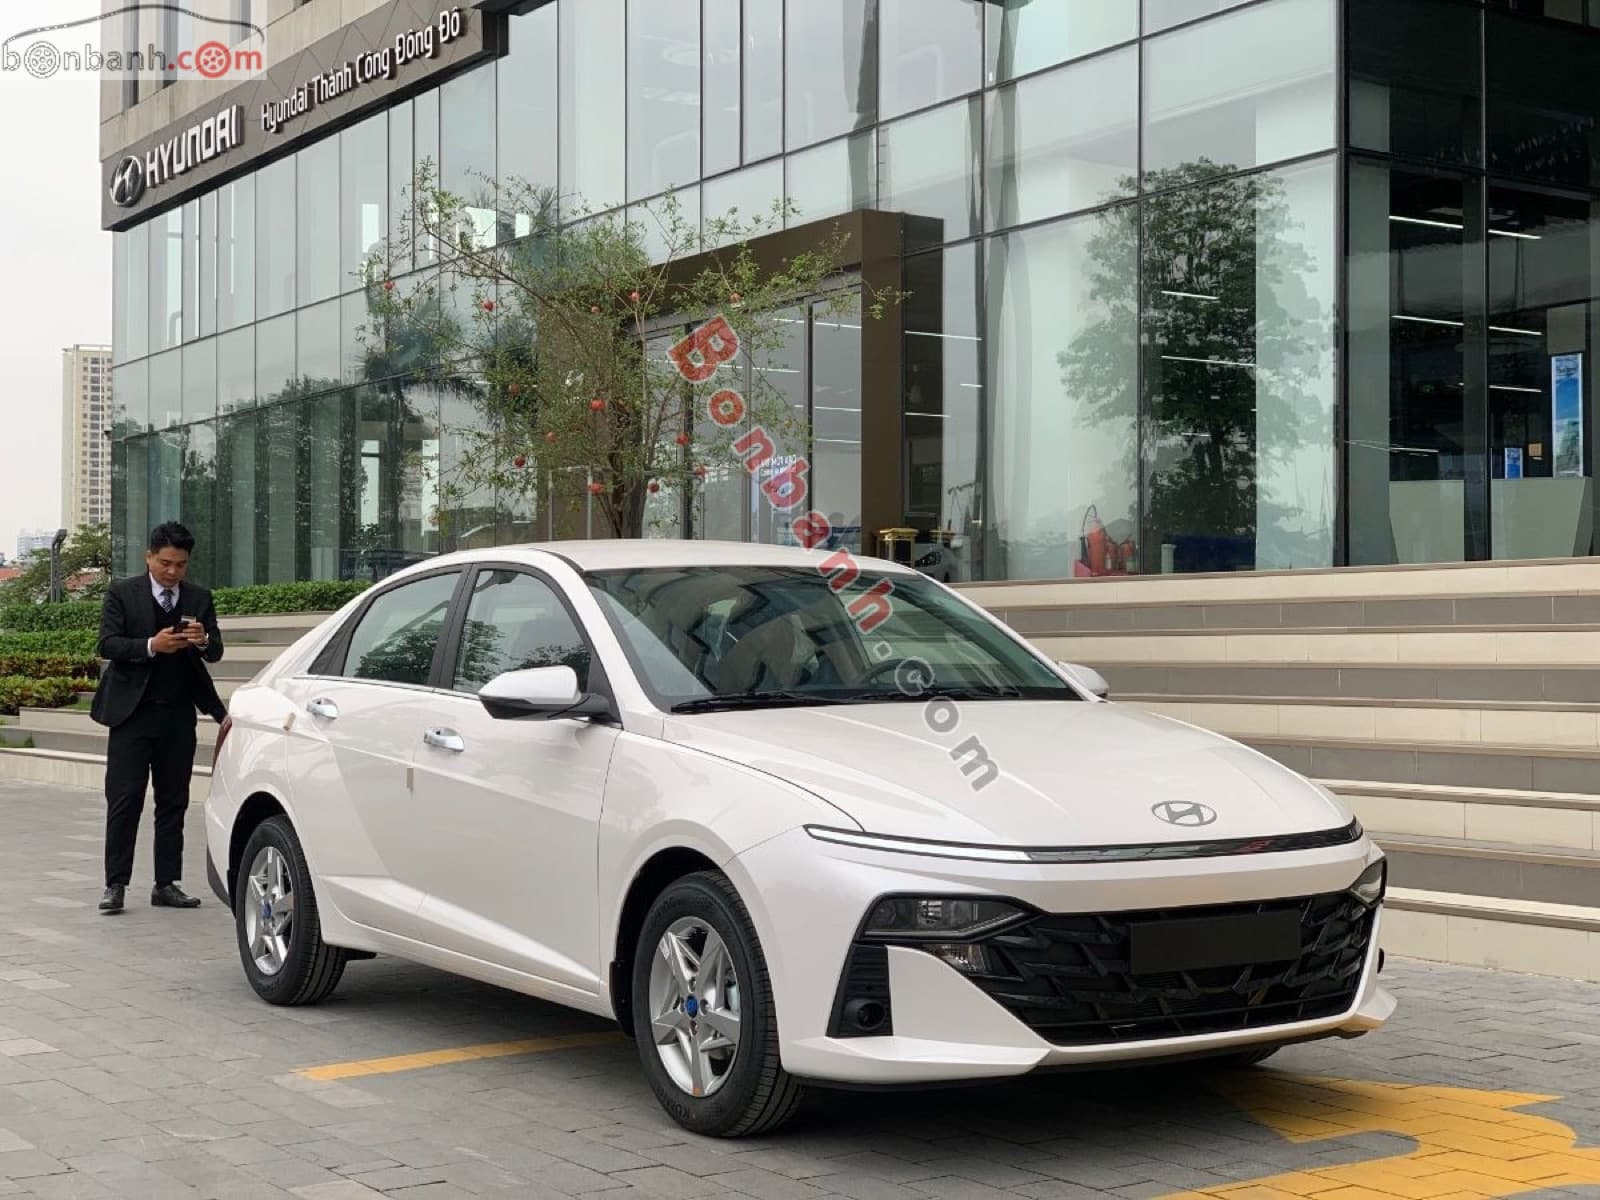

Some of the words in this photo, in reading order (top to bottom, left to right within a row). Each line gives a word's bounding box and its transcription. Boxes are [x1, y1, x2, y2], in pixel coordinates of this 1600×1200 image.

[261, 81, 309, 133] Hyundai
[312, 61, 353, 104] Thành
[356, 50, 391, 83] Công
[395, 28, 433, 65] Đông
[439, 6, 461, 43] Đô
[146, 103, 238, 188] HYUNDAI
